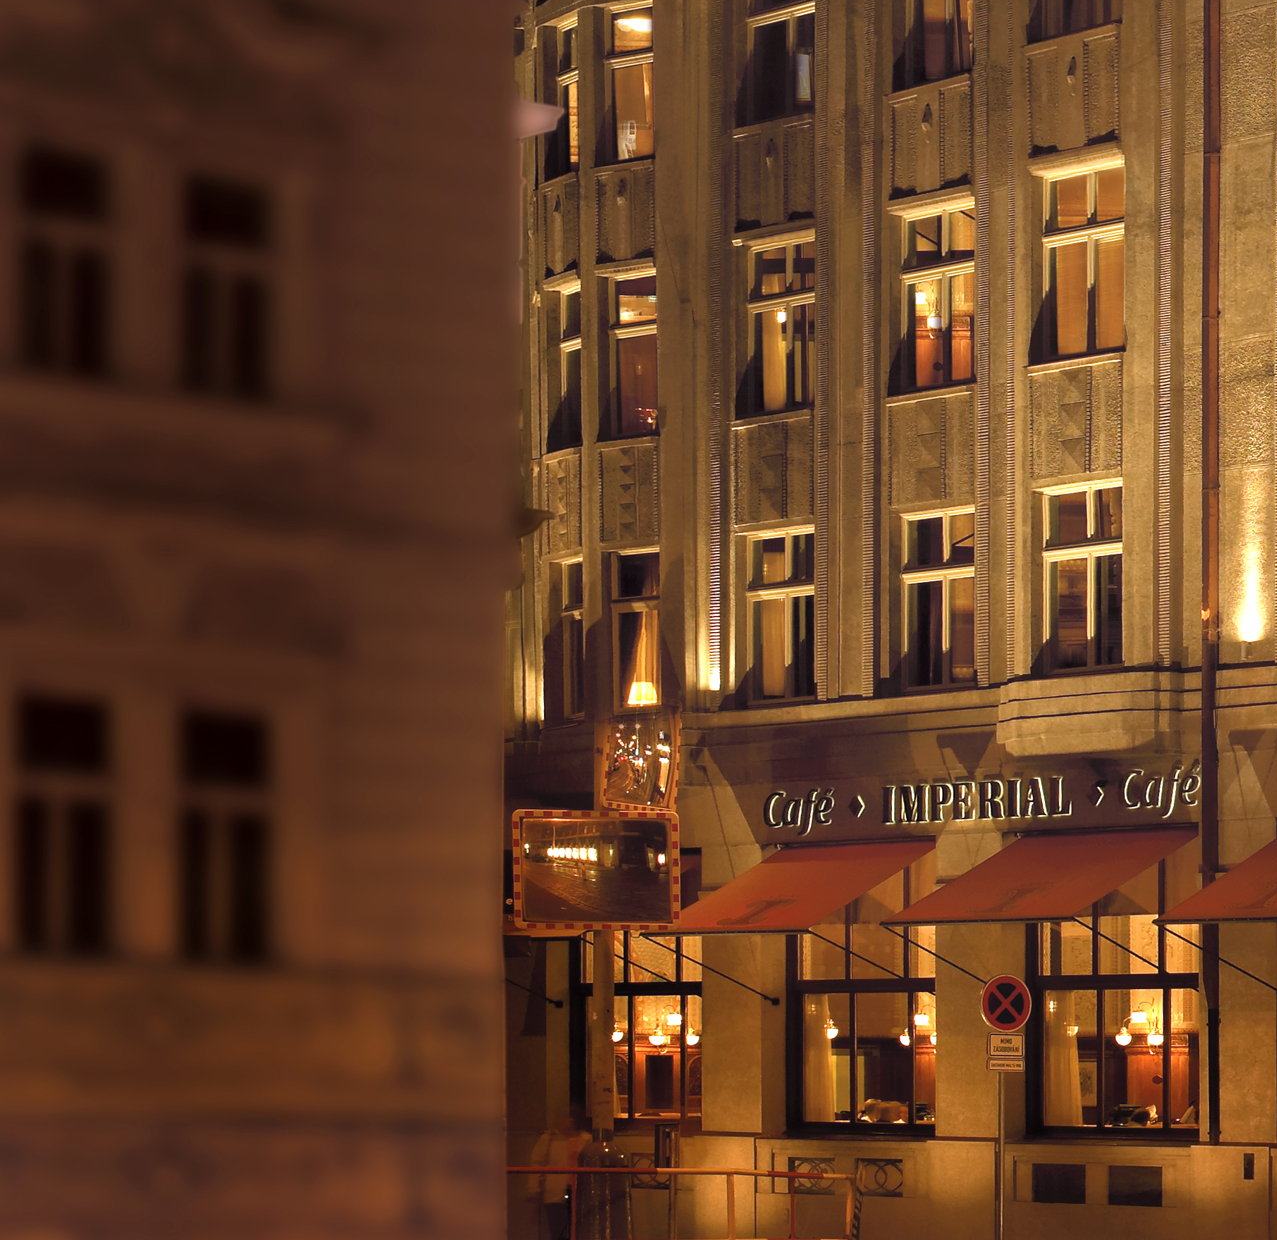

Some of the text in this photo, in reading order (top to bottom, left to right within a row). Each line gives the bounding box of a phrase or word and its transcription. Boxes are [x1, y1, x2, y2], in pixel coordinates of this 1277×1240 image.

[763, 764, 1200, 837] Café IMPERIAL Café
